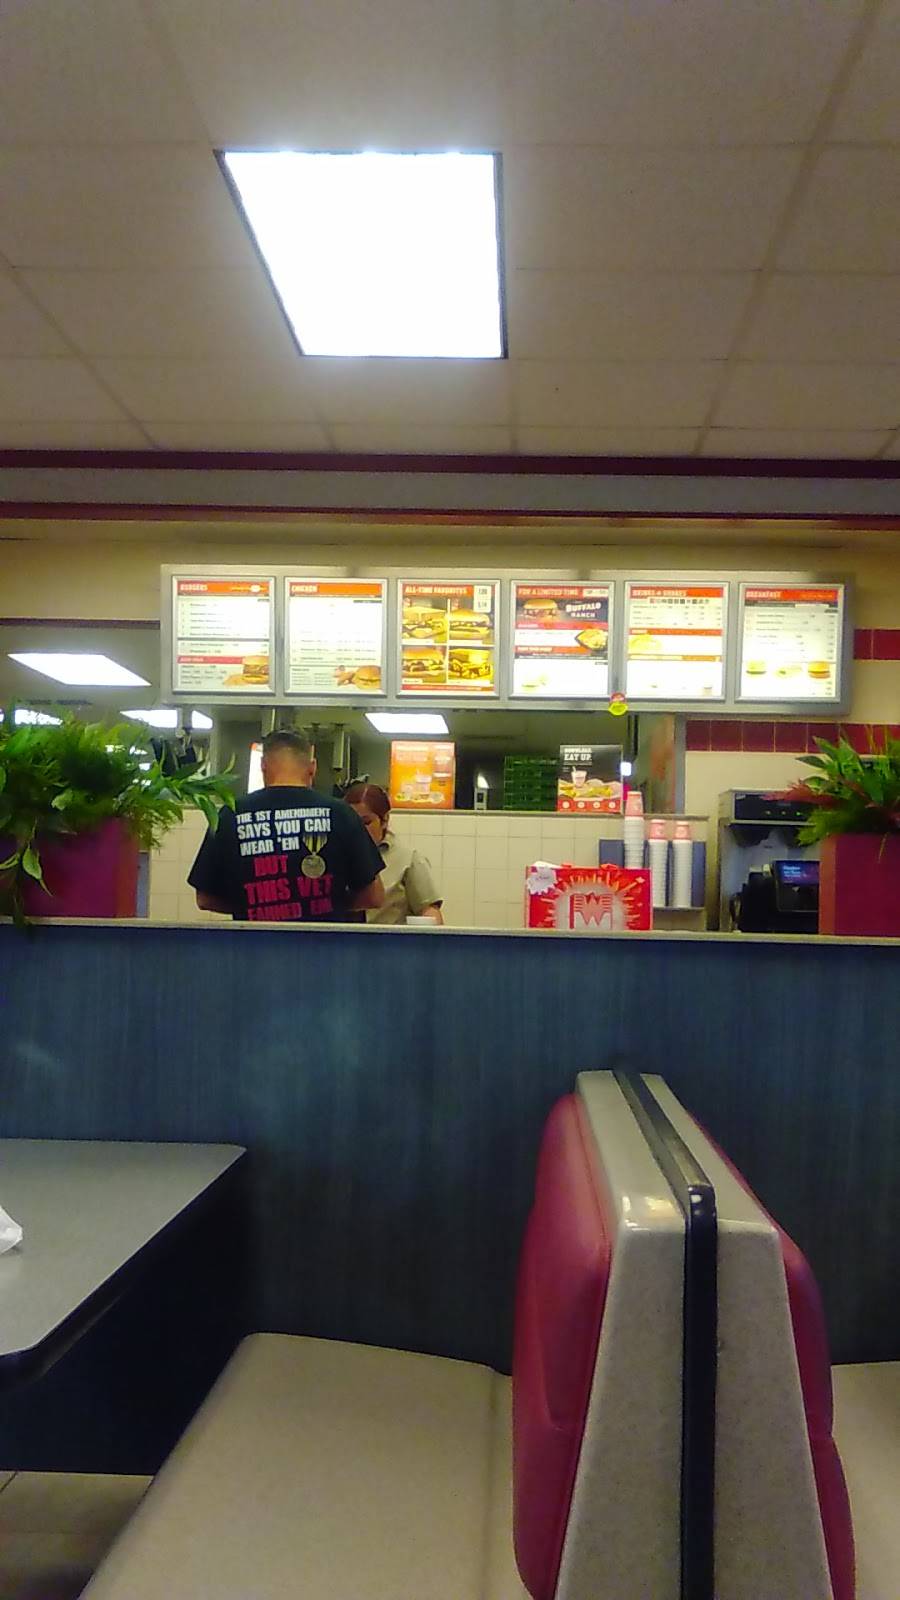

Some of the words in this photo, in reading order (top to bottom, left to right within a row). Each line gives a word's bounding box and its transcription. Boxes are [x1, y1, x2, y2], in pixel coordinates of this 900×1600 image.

[565, 602, 602, 613] BUFFALO
[564, 753, 579, 761] EAT
[236, 812, 253, 825] THE
[254, 810, 272, 821] 1ST
[274, 807, 331, 820] AMENDMENT
[237, 822, 271, 840] SAYS
[274, 819, 301, 836] YOU
[304, 818, 331, 833] CAN
[240, 839, 275, 857] WEAR
[277, 836, 299, 851] 'EM
[254, 854, 288, 877] BUT
[244, 877, 291, 905] THIS
[297, 874, 333, 897] VET
